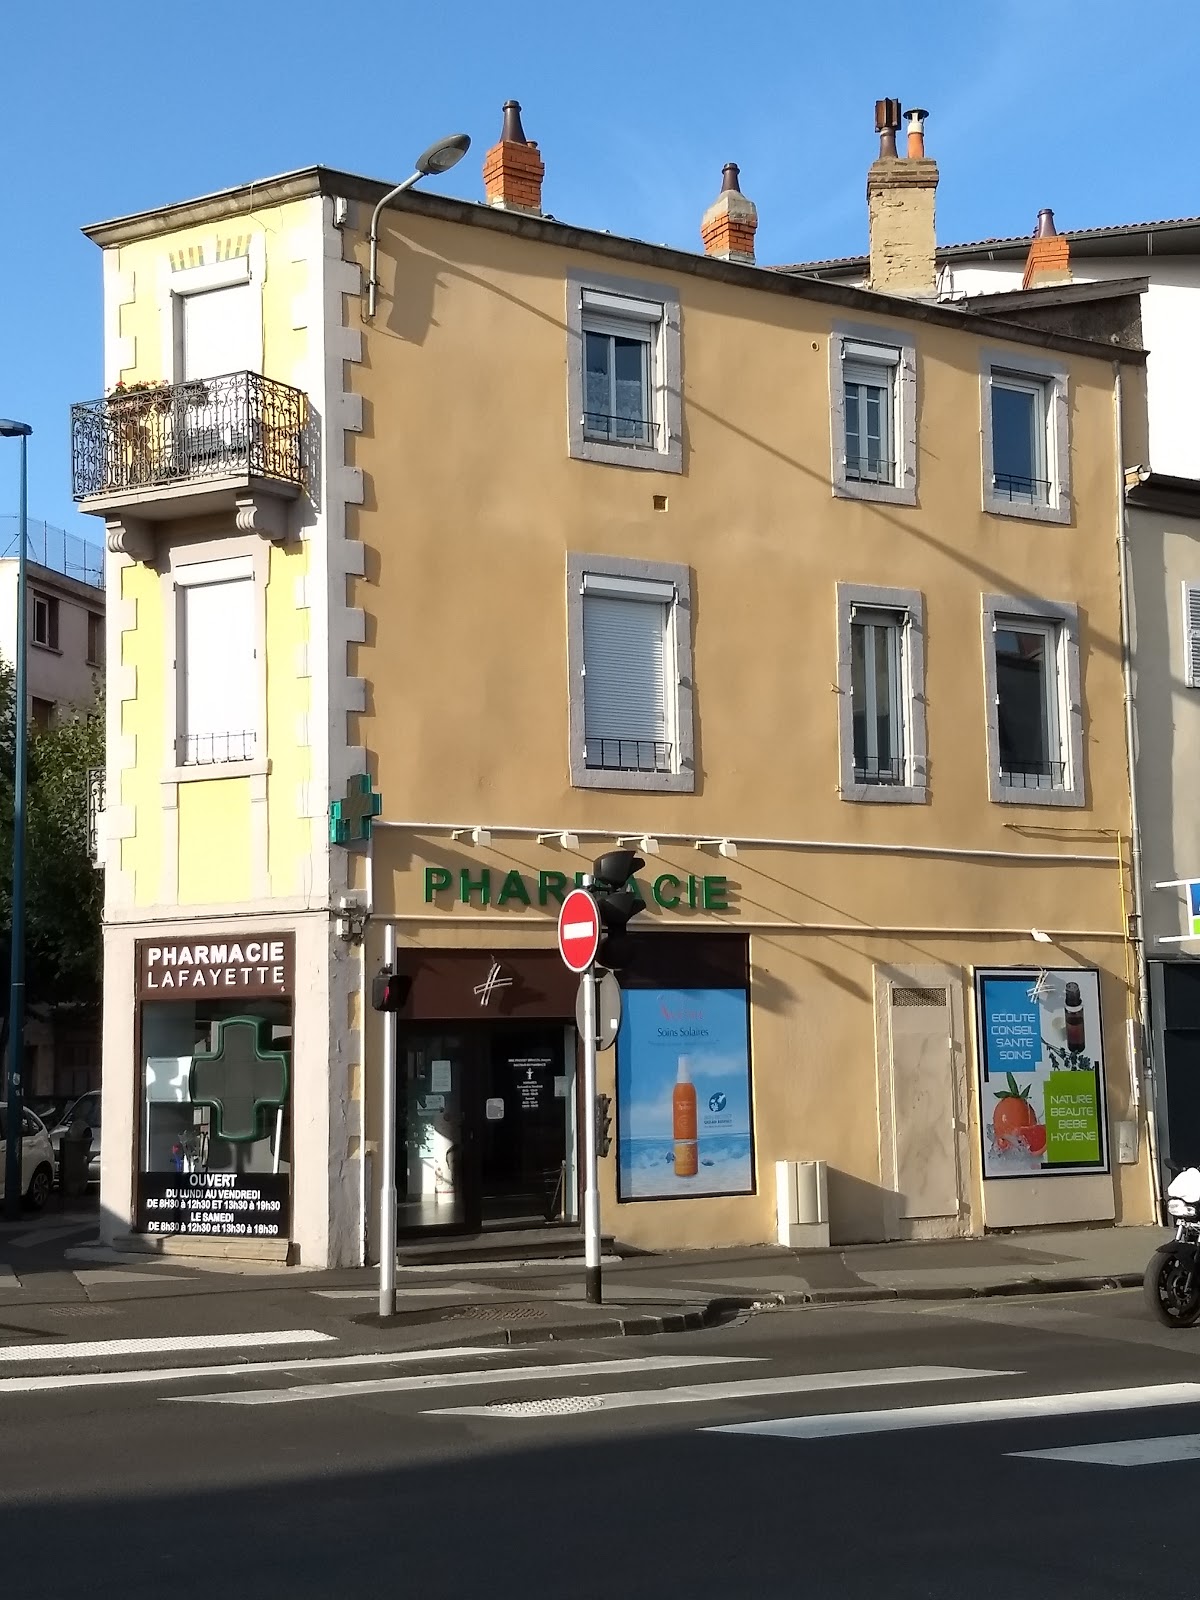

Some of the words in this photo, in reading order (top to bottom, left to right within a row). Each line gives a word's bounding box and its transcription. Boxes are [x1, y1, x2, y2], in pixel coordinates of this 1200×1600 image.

[423, 866, 729, 910] PHARCIE
[147, 941, 285, 967] PHARMACIE
[147, 966, 285, 988] LAFAYETTE
[991, 1013, 1036, 1023] ECOUTE
[657, 1027, 679, 1037] Soins
[680, 1027, 709, 1037] Solaires
[991, 1025, 1037, 1035] CONSEIL
[996, 1038, 1034, 1048] SANTE
[999, 1050, 1032, 1060] SOINS
[1050, 1094, 1093, 1104] NATURE
[1050, 1106, 1094, 1117] BEAUTE
[1058, 1119, 1088, 1129] BEBE
[1050, 1131, 1096, 1142] HYGIENE
[189, 1173, 238, 1187] OUVERT
[165, 1188, 178, 1198] DU
[179, 1189, 204, 1199] LUNDI
[204, 1189, 218, 1199] AU
[217, 1189, 261, 1200] VENDREDI
[146, 1198, 159, 1208] DE
[180, 1199, 186, 1209] à
[187, 1200, 211, 1210] 12h30
[211, 1200, 223, 1210] ET
[224, 1200, 248, 1210] 13h30
[248, 1200, 255, 1210] à
[190, 1211, 202, 1222] LE
[202, 1211, 235, 1222] SAMEDI
[148, 1221, 160, 1231] DE
[160, 1221, 180, 1231] 8h30
[180, 1222, 187, 1232] à
[187, 1222, 211, 1232] 12h30
[211, 1223, 221, 1233] et
[221, 1223, 246, 1233] 13h30
[246, 1224, 253, 1233] à
